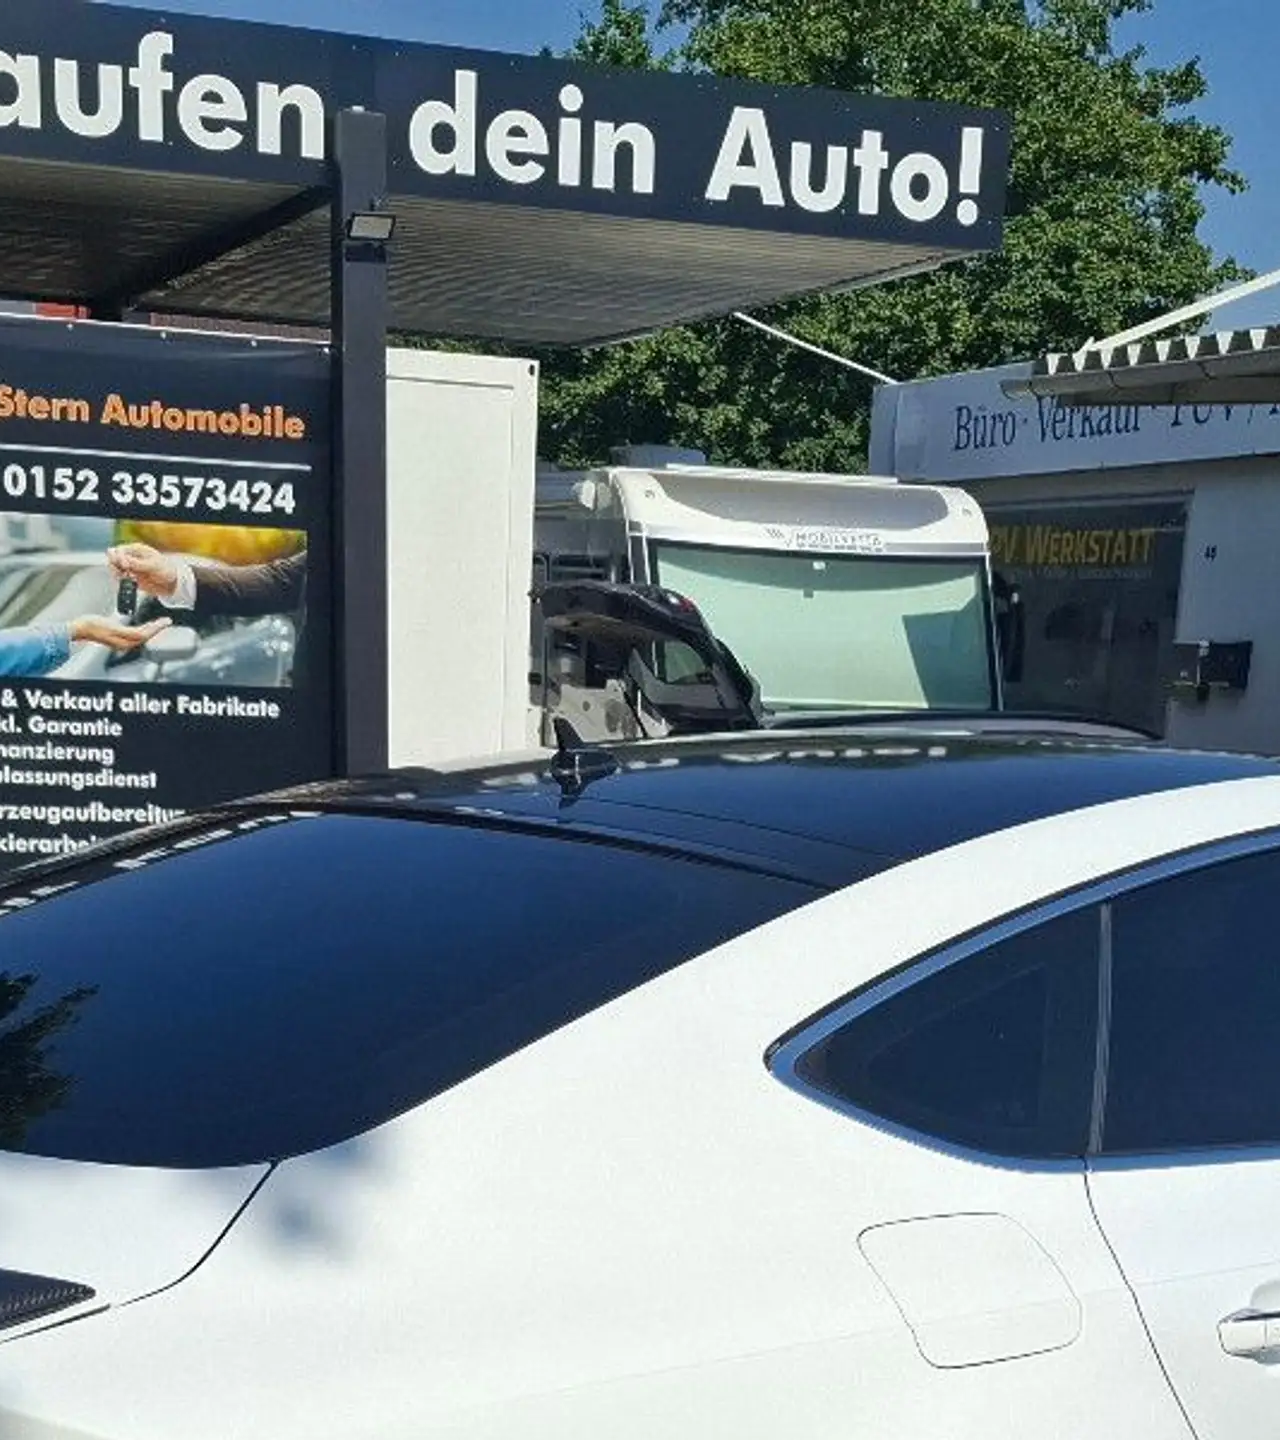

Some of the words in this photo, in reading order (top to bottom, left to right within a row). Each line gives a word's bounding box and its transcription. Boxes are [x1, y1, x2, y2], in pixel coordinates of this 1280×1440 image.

[409, 69, 656, 193] dein
[704, 106, 983, 226] Auto!
[101, 393, 305, 439] Automobile
[954, 405, 1017, 450] Büro
[3, 463, 98, 501] 0152
[111, 472, 296, 515] 33573424
[1, 689, 18, 708] &
[25, 689, 114, 712] Verkauf
[119, 692, 170, 714] aller
[177, 696, 281, 718] Fabrikate
[28, 716, 122, 737] Garantie
